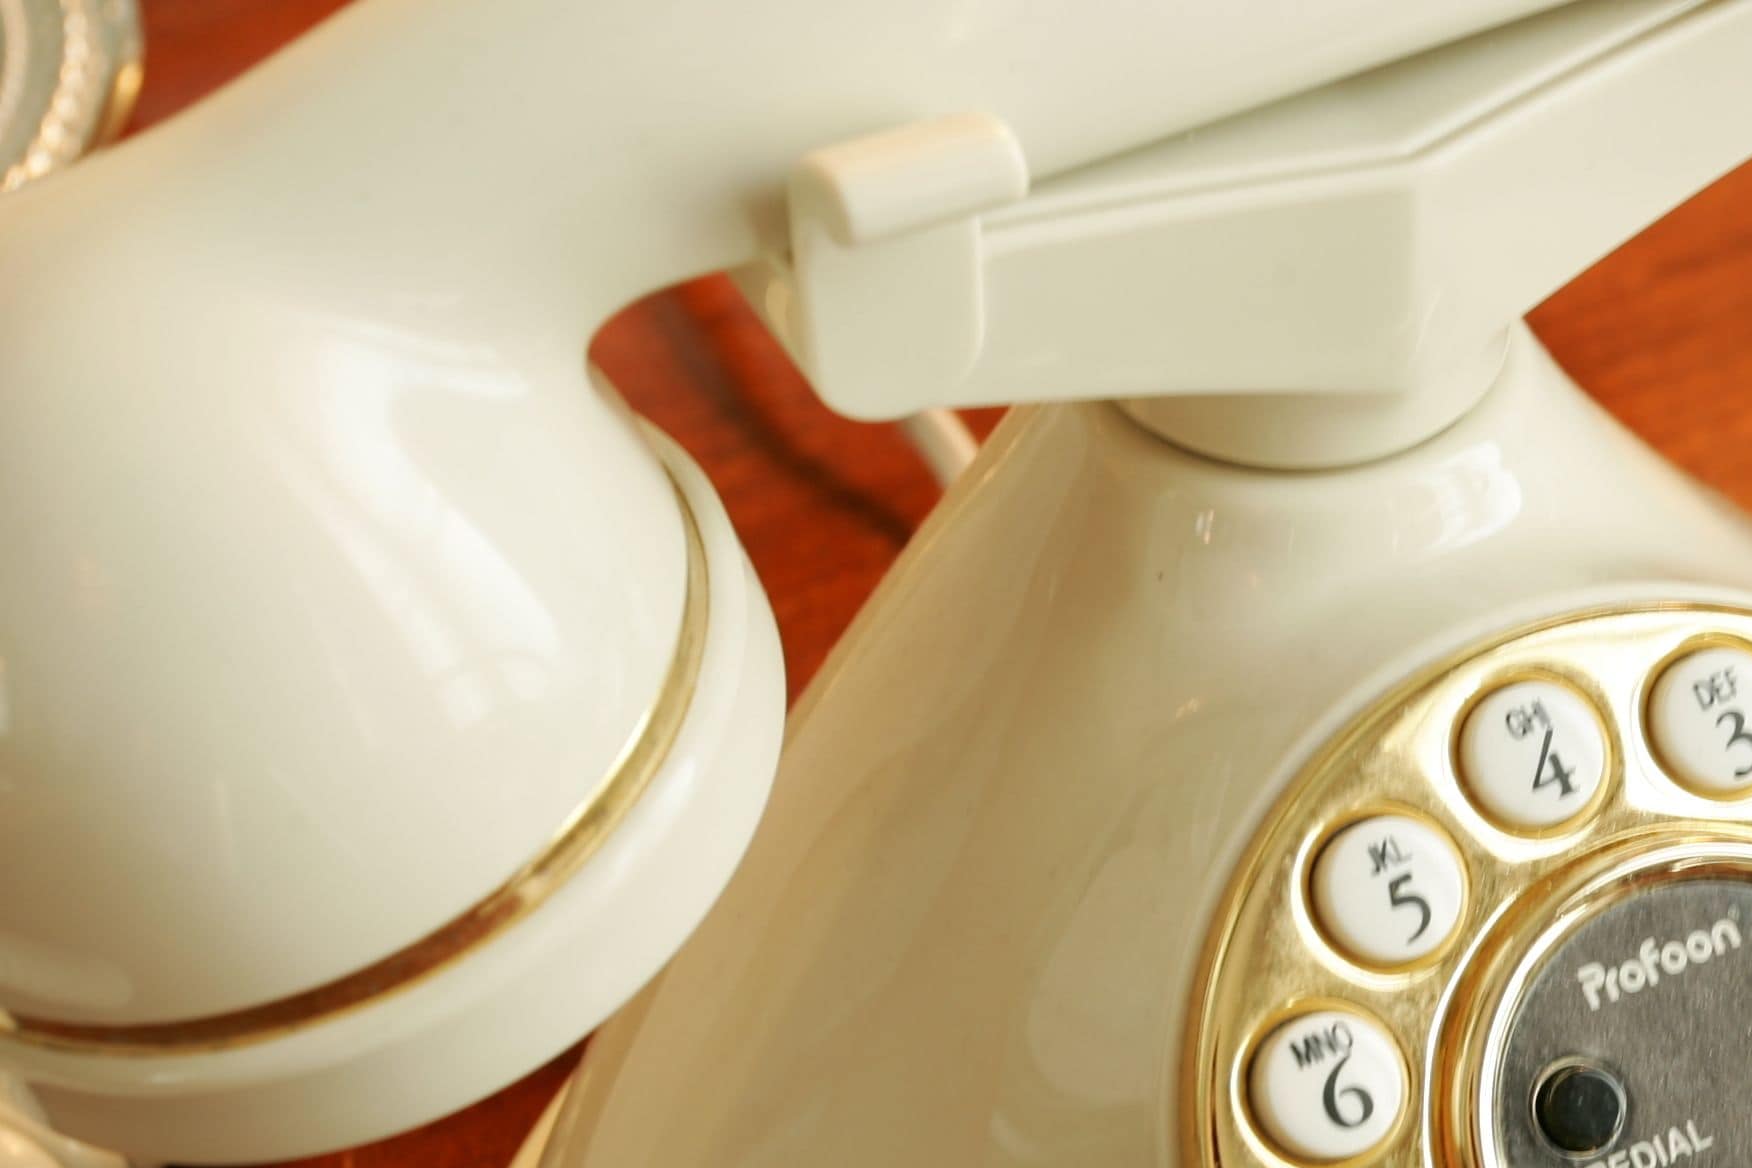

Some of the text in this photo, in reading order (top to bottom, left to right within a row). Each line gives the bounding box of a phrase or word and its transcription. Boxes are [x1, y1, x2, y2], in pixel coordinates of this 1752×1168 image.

[1505, 697, 1551, 740] GHI
[1693, 666, 1737, 711] DEF
[1532, 727, 1580, 799] 4
[1368, 835, 1413, 877] JKL
[1389, 872, 1432, 946] 5
[1577, 918, 1741, 1012] Profoon
[1290, 1021, 1354, 1071] MNO
[1323, 1055, 1374, 1128] 6
